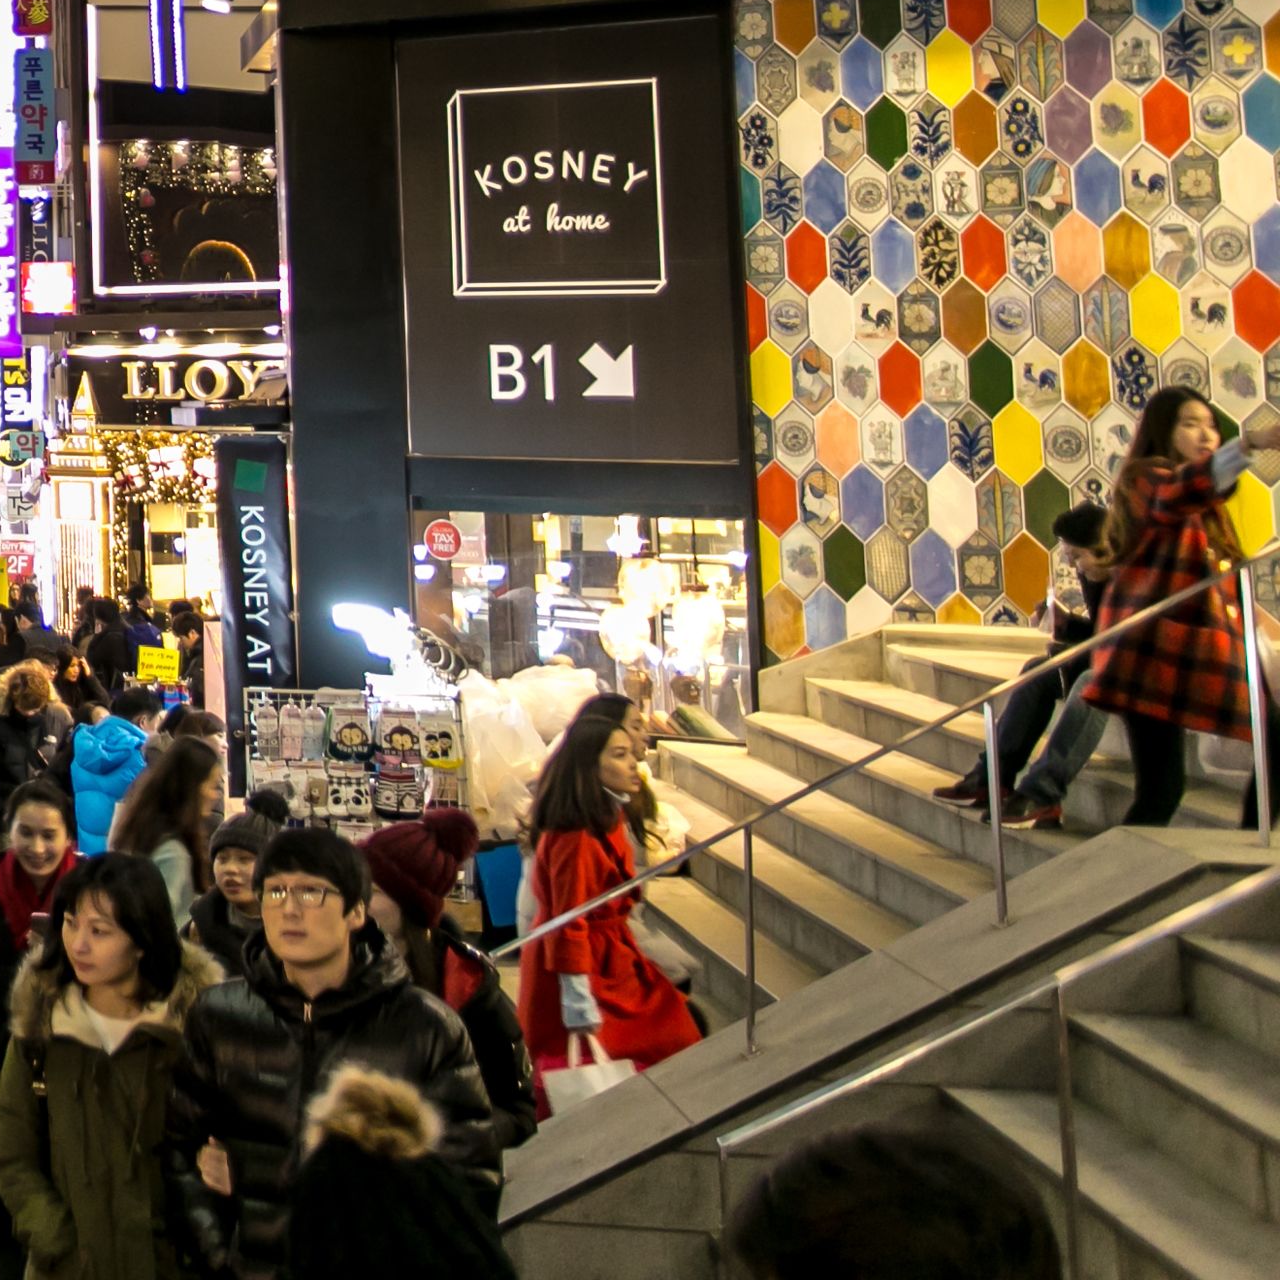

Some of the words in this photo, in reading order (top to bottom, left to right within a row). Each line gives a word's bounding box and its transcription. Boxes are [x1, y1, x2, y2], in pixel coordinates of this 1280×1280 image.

[22, 57, 48, 154] 푸른약국
[474, 150, 648, 197] KOSNEY
[503, 205, 532, 232] at
[546, 203, 611, 231] home
[121, 359, 285, 401] LLOY
[489, 344, 554, 401] B1
[432, 533, 454, 544] TAX
[433, 543, 455, 552] FREE
[8, 556, 29, 574] 2F
[240, 506, 271, 627] KOSNEY
[246, 634, 273, 677] AT
